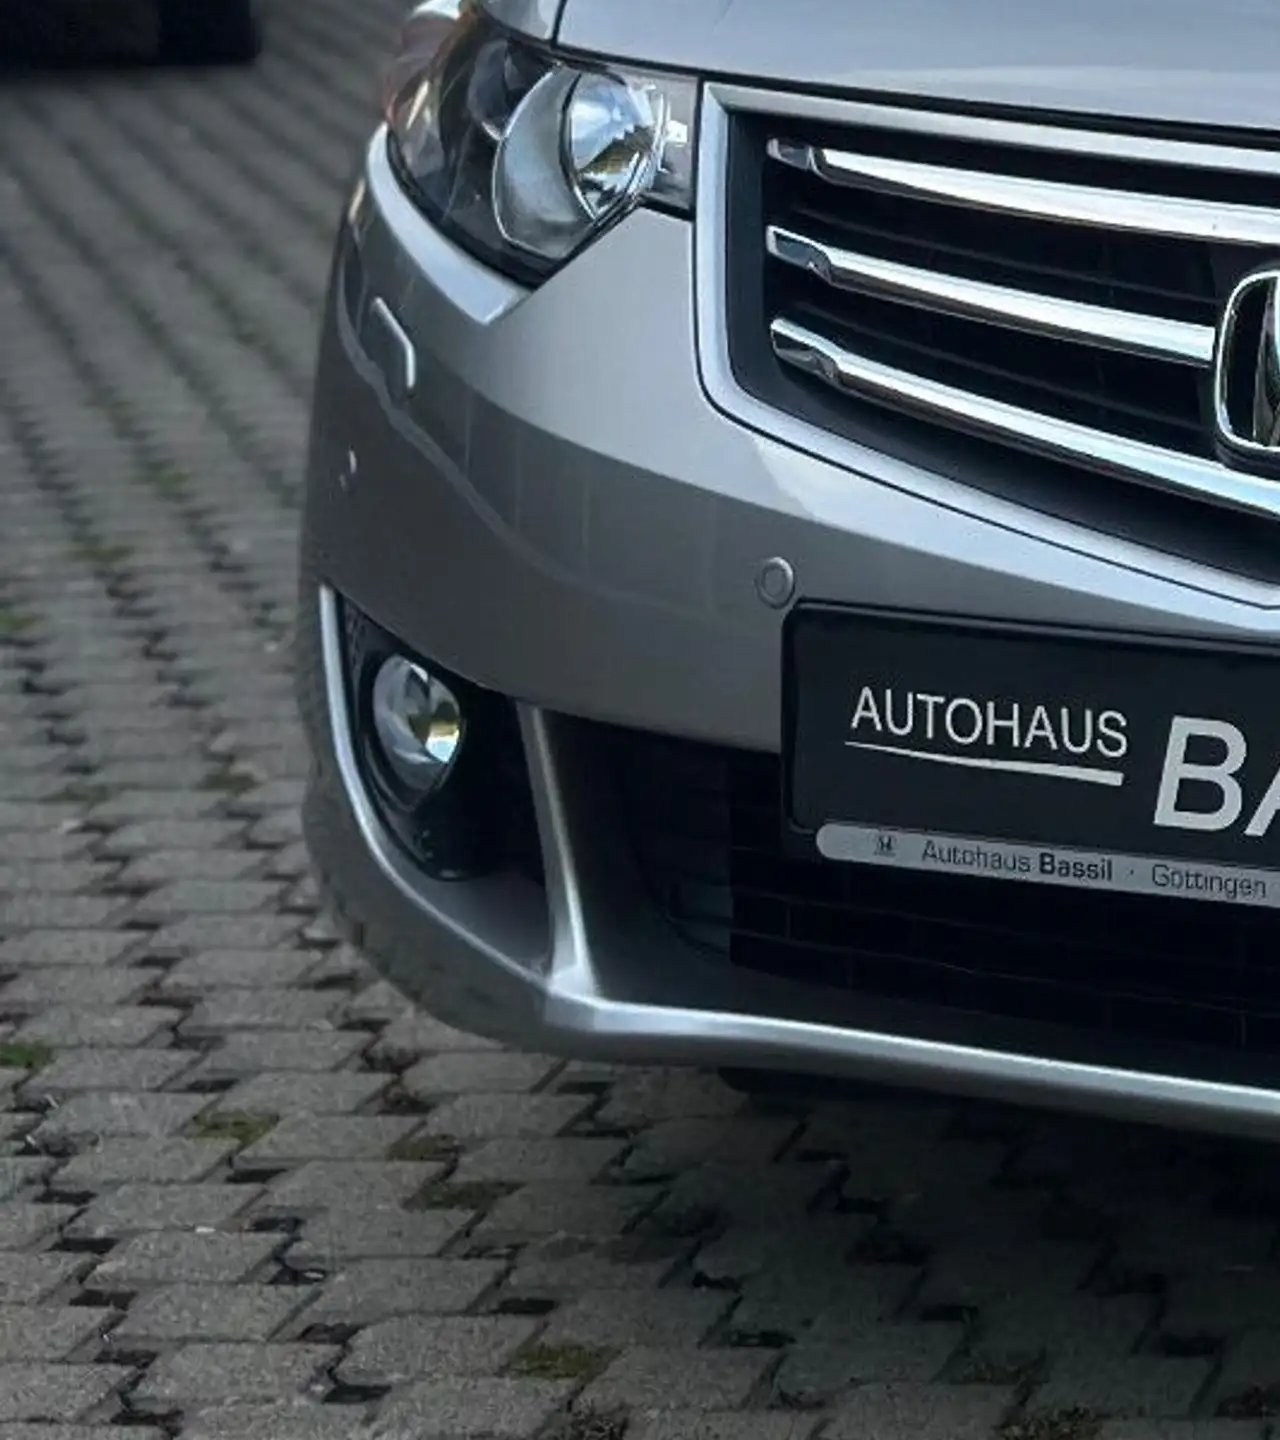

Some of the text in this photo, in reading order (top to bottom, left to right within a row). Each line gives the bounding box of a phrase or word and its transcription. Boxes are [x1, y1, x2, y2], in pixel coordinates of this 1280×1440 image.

[850, 685, 1129, 759] AUTOHAUS
[921, 839, 1031, 874] Autohaus
[1038, 851, 1113, 882] Bassil
